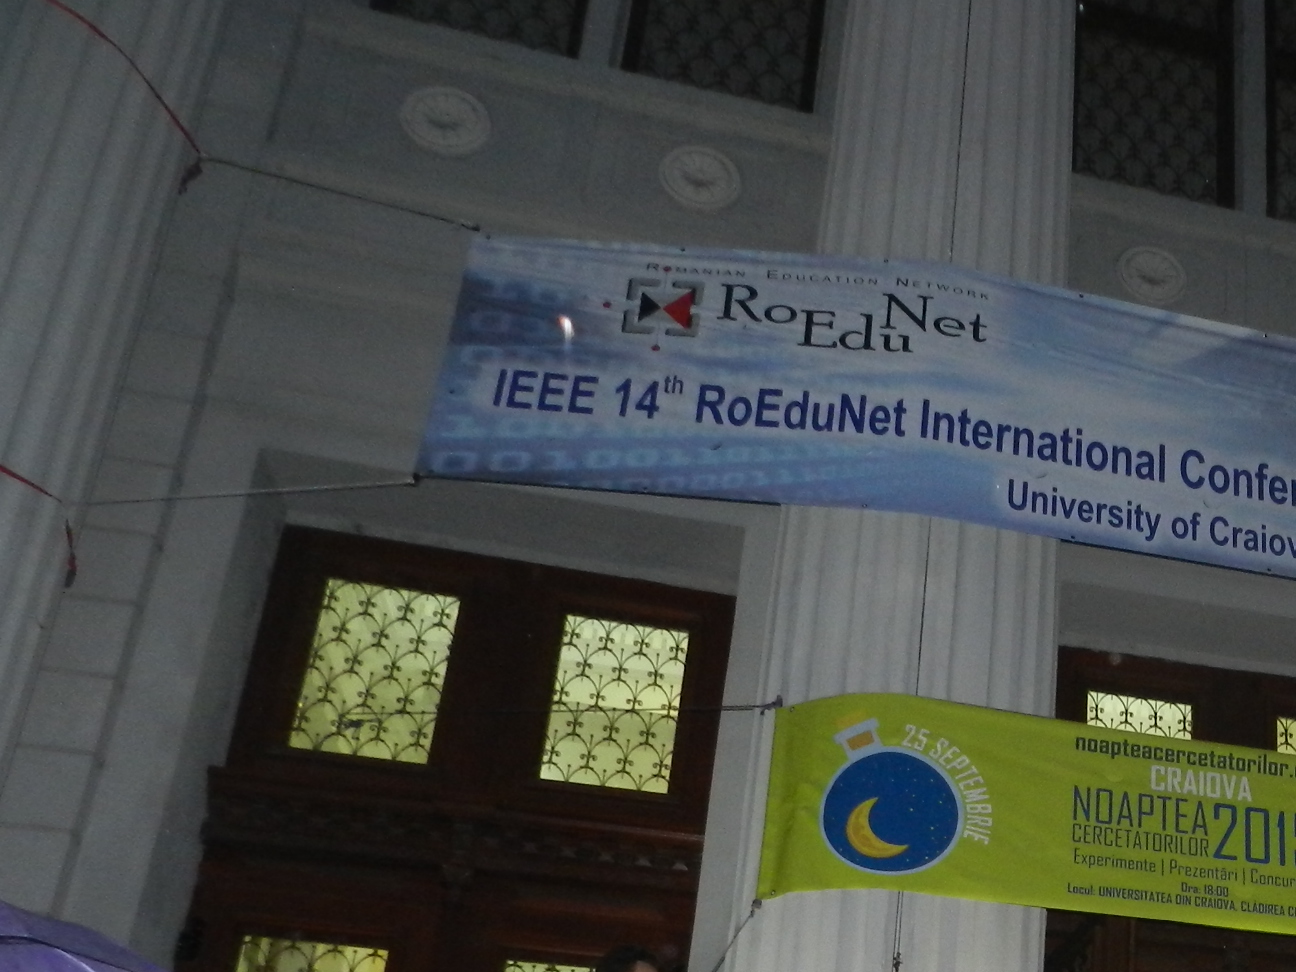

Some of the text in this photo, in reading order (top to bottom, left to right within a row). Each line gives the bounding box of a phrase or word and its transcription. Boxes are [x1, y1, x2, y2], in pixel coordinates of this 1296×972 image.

[646, 262, 746, 278] RMANIAN
[493, 367, 600, 416] IEEE
[615, 375, 684, 420] 14th
[695, 384, 908, 439] RoEduNet
[919, 399, 1167, 484] International
[1007, 477, 1161, 543] University
[1171, 507, 1202, 543] of
[901, 723, 994, 847] 25 SEPTEMBRIE
[1149, 763, 1253, 803] CRAIOVA
[1072, 783, 1209, 837] NOAPTEA
[1071, 822, 1210, 859] CERCETATORILOR
[1073, 847, 1157, 873] Experimente
[1098, 885, 1173, 905] UNIVERSITATEA
[1175, 893, 1192, 906] DIN
[1202, 882, 1230, 898] 18:00
